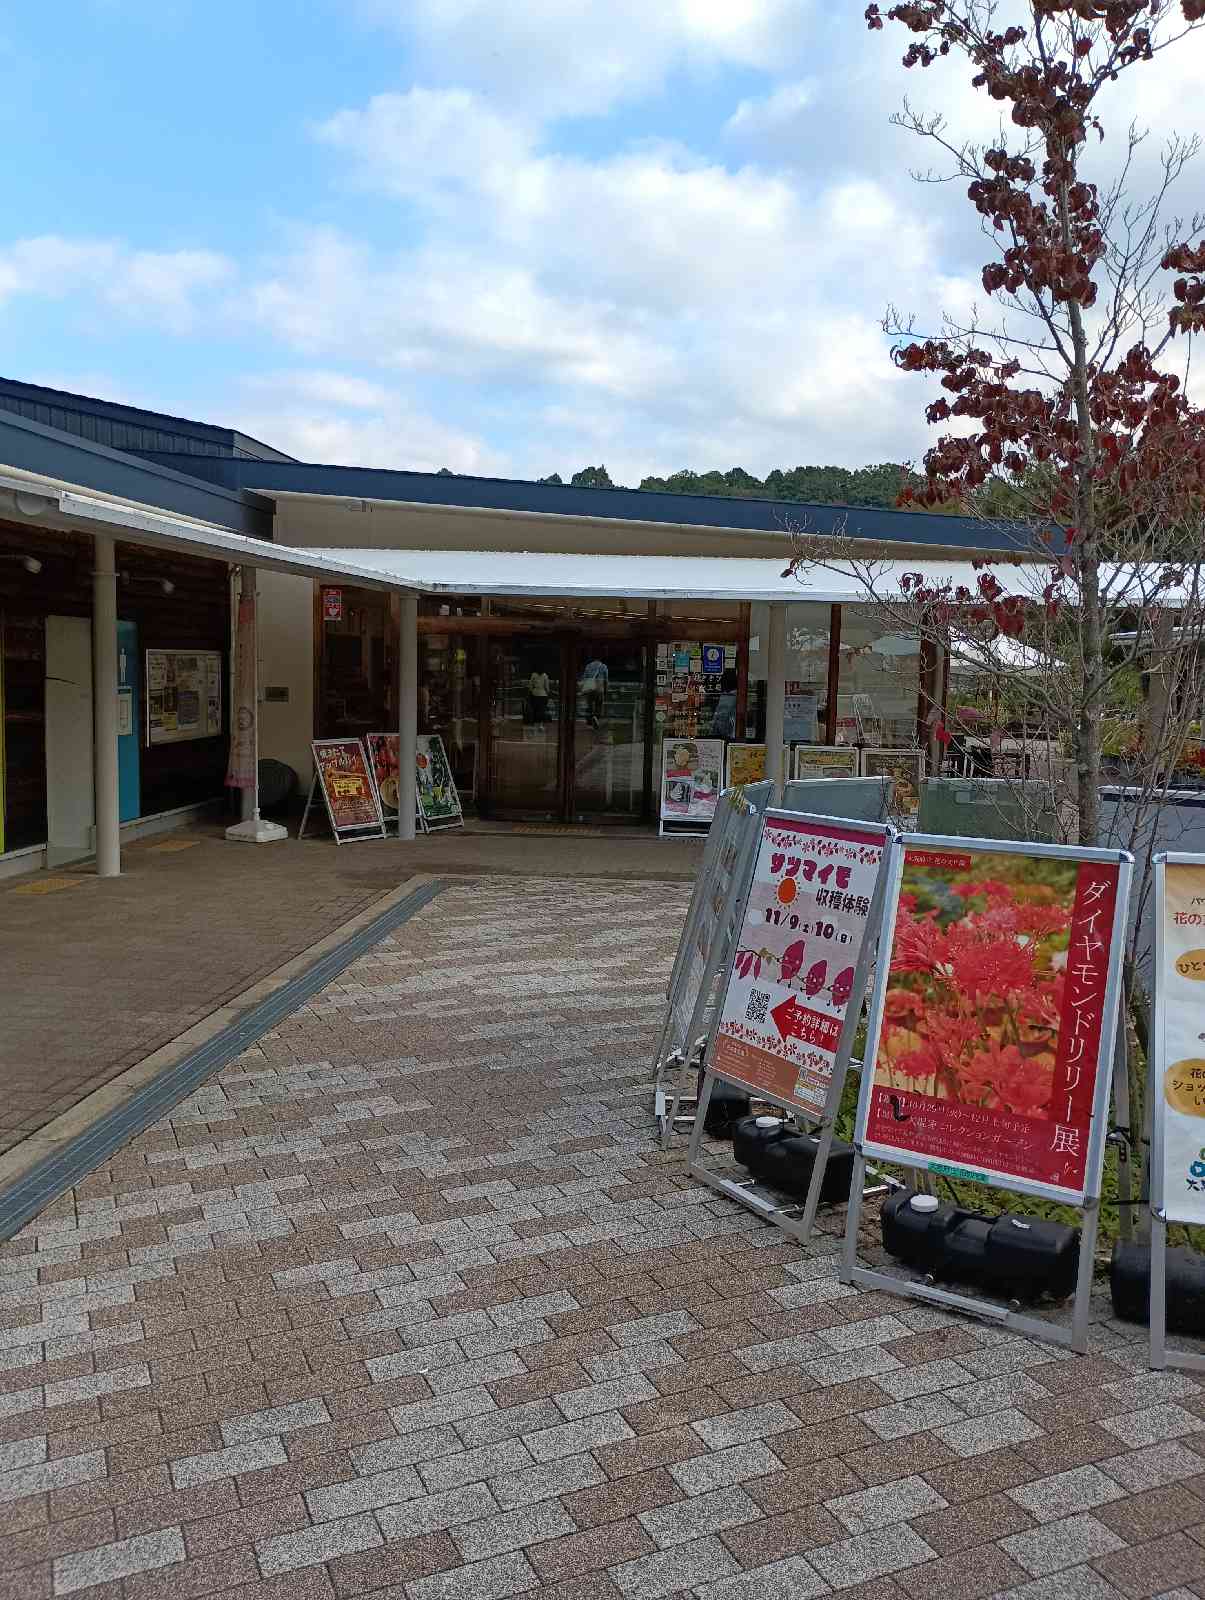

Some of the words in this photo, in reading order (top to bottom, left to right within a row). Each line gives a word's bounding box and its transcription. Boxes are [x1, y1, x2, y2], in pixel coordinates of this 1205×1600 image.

[770, 852, 852, 889] サツマイモ
[815, 887, 870, 917] 収穫体験
[1173, 911, 1205, 926] 花の
[785, 1006, 840, 1036] ご予約詳細は
[1051, 880, 1112, 1157] ダイヤモンドリリー展
